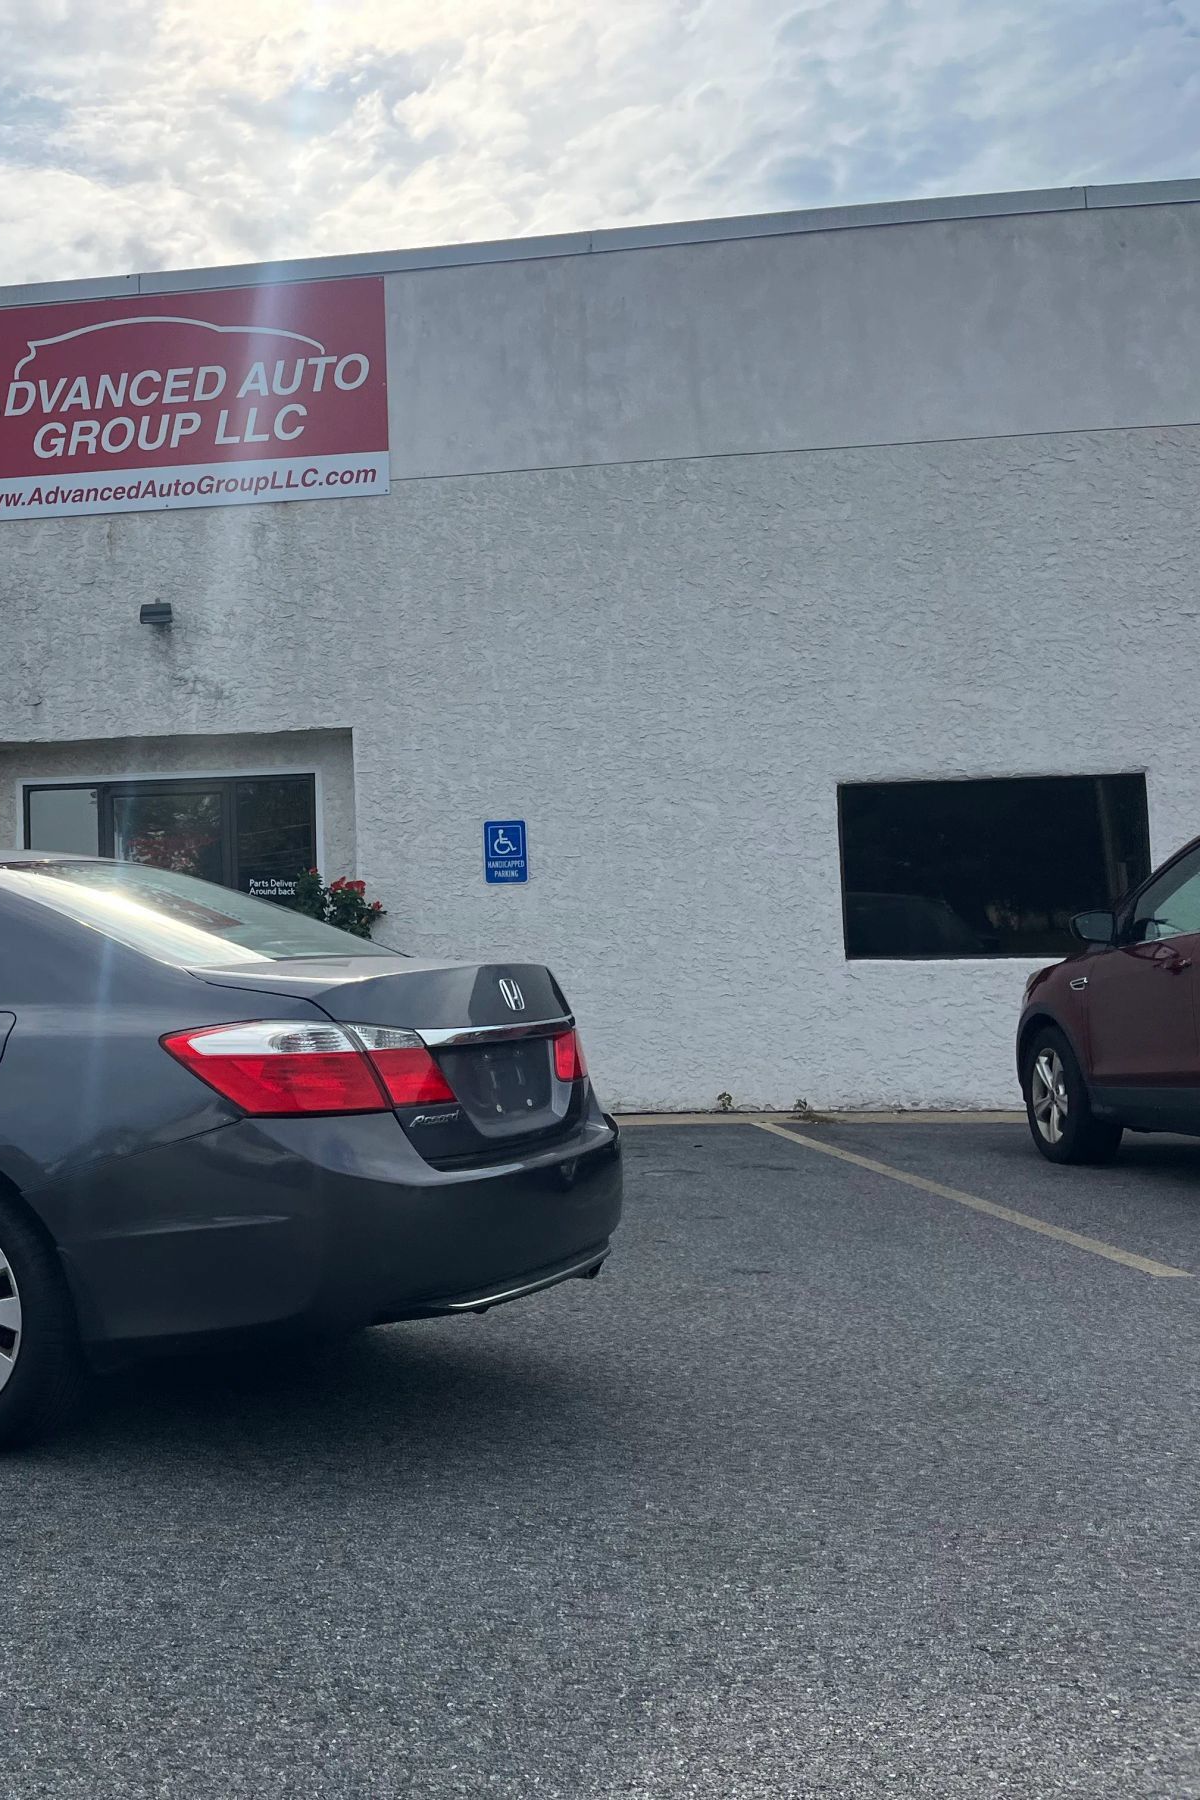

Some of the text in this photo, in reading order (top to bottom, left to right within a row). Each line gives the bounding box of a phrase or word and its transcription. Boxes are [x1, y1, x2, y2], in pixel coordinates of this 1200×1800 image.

[236, 353, 370, 398] AUTO
[33, 403, 308, 459] GROUP LLC
[487, 860, 525, 868] HANDICAPPED
[494, 870, 519, 878] PARKING
[249, 879, 298, 888] Parts Deliver
[249, 887, 296, 895] Around back
[409, 1109, 460, 1128] Accord
